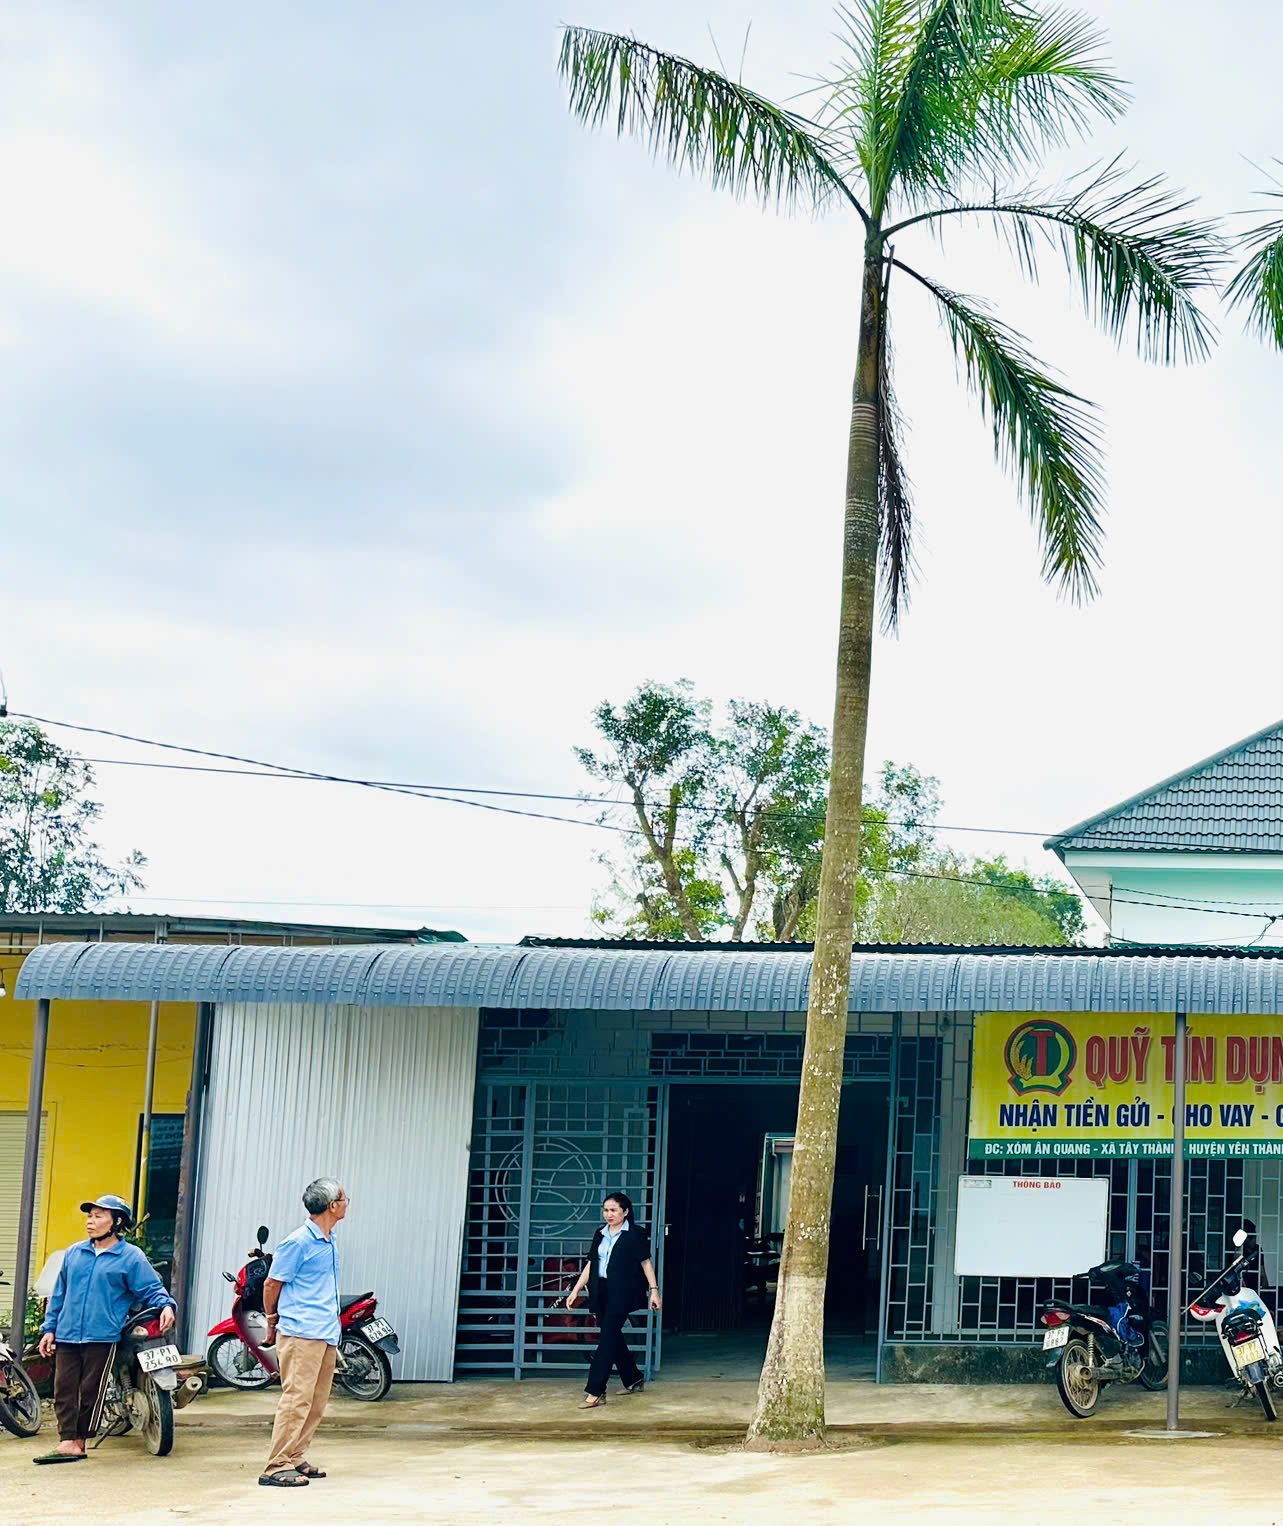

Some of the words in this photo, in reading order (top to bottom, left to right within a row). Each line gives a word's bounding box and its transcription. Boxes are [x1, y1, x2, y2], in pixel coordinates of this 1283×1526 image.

[1085, 1026, 1151, 1089] QUỸ
[1161, 1026, 1215, 1084] TÍN
[999, 1099, 1057, 1132] NHẬN
[1064, 1096, 1109, 1127] TIỀN
[1116, 1096, 1150, 1127] GỬI
[1219, 1104, 1255, 1127] VAY
[985, 1143, 1003, 1155] ĐC:
[1053, 1143, 1091, 1155] QUANG
[1101, 1142, 1116, 1154] XÃ
[1119, 1142, 1141, 1155] TÂY
[1189, 1141, 1227, 1157] HUYỆN
[1229, 1142, 1249, 1155] YÊN
